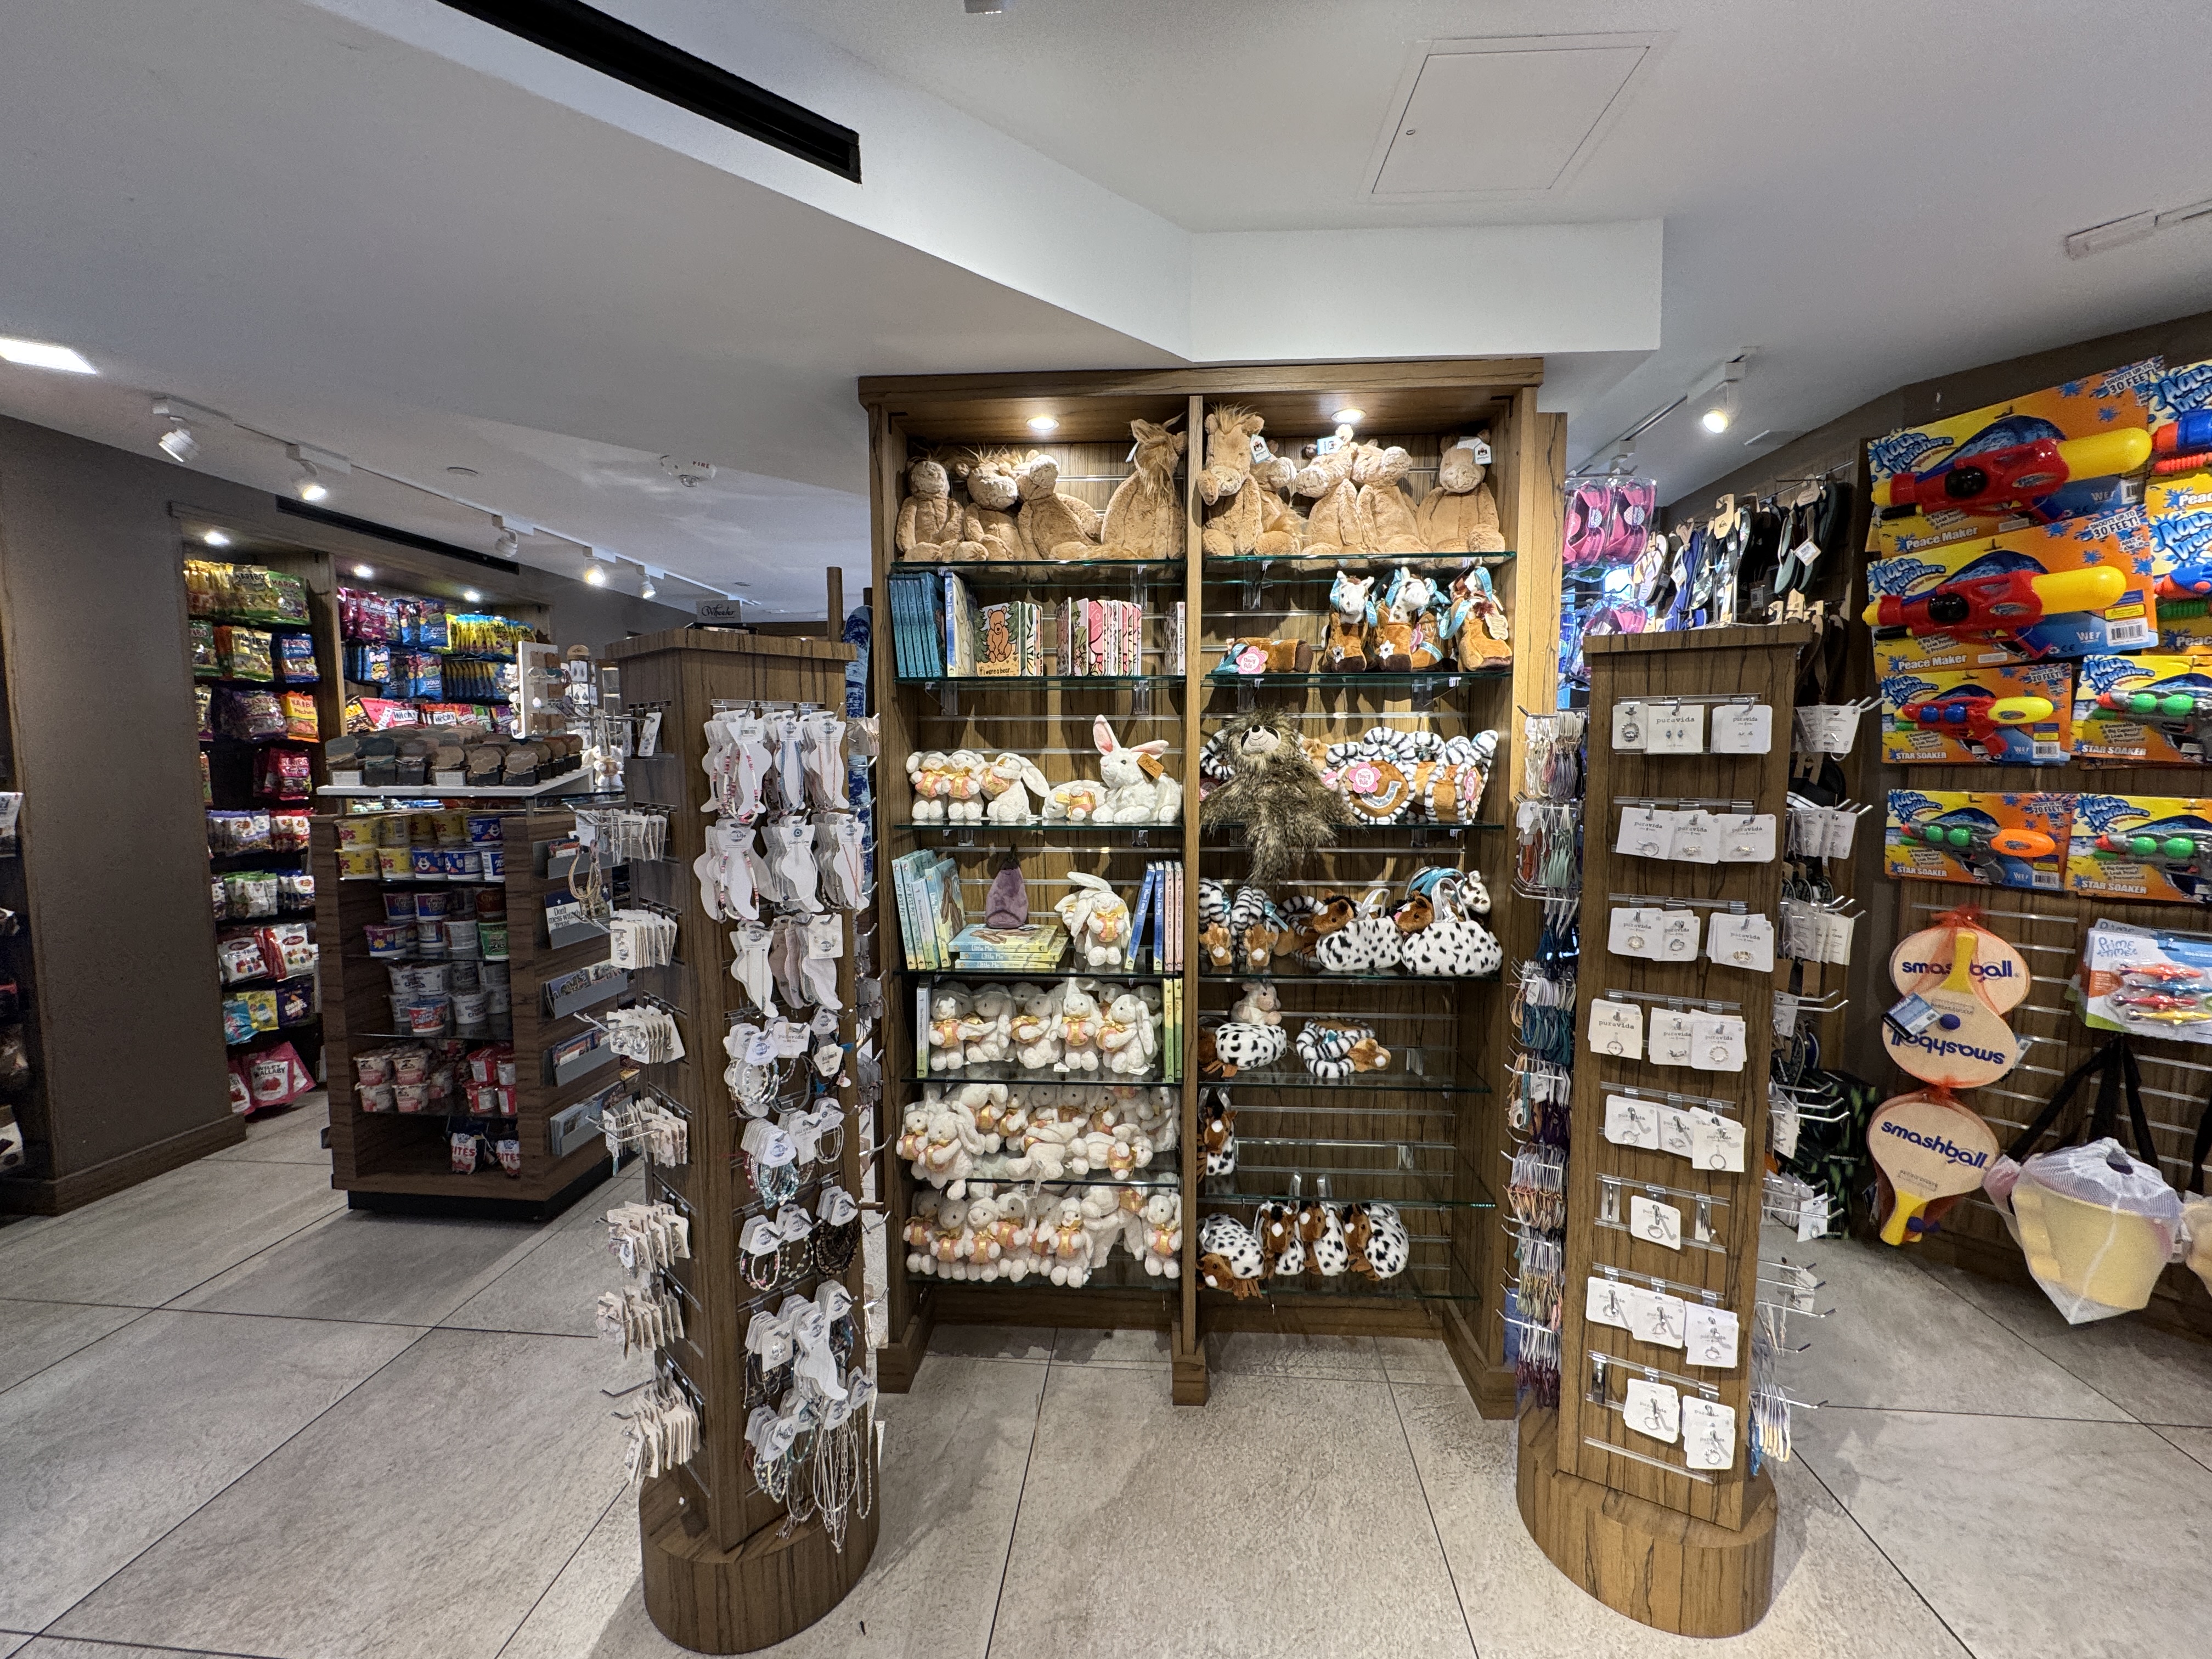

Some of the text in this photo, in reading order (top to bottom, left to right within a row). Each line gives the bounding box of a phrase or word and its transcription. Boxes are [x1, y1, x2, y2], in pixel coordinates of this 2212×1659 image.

[2109, 381, 2125, 394] 30
[2094, 517, 2139, 538] 30 FEET!
[1906, 526, 1978, 549] Peace Maker
[701, 603, 735, 618] Wheeler
[1898, 654, 1967, 670] Peace Maker
[1916, 752, 1947, 760] SOAKER
[2081, 745, 2147, 756] STAR SOAKER
[1897, 866, 1948, 878] STAR SOAKER
[896, 884, 901, 894] MY
[906, 883, 911, 893] MY
[2081, 881, 2147, 894] STAR SOAKER
[932, 906, 939, 914] Me
[1730, 932, 1760, 941] puravida
[1901, 960, 2013, 980] smasball
[1599, 1020, 1634, 1030] puravida
[253, 1066, 286, 1078] WALLABY
[1881, 1121, 1988, 1169] smashball
